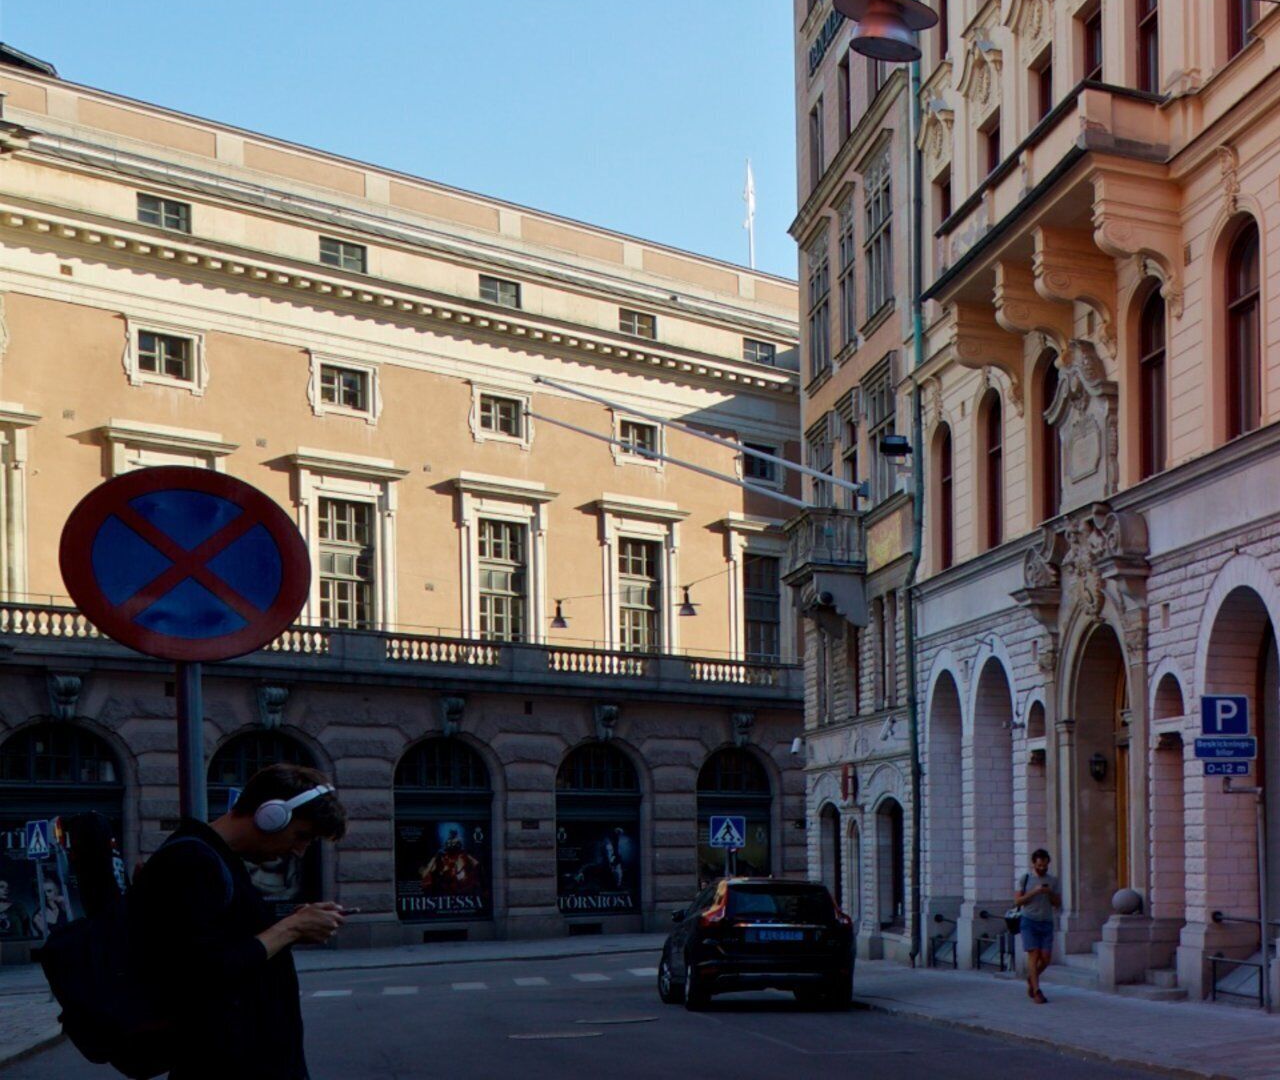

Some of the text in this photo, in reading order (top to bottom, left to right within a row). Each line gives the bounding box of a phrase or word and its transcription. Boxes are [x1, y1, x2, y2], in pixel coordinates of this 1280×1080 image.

[1216, 700, 1238, 731] P
[1207, 763, 1233, 773] 0-12
[398, 896, 483, 911] TRISTESSA
[558, 894, 633, 910] TÖRNROSA
